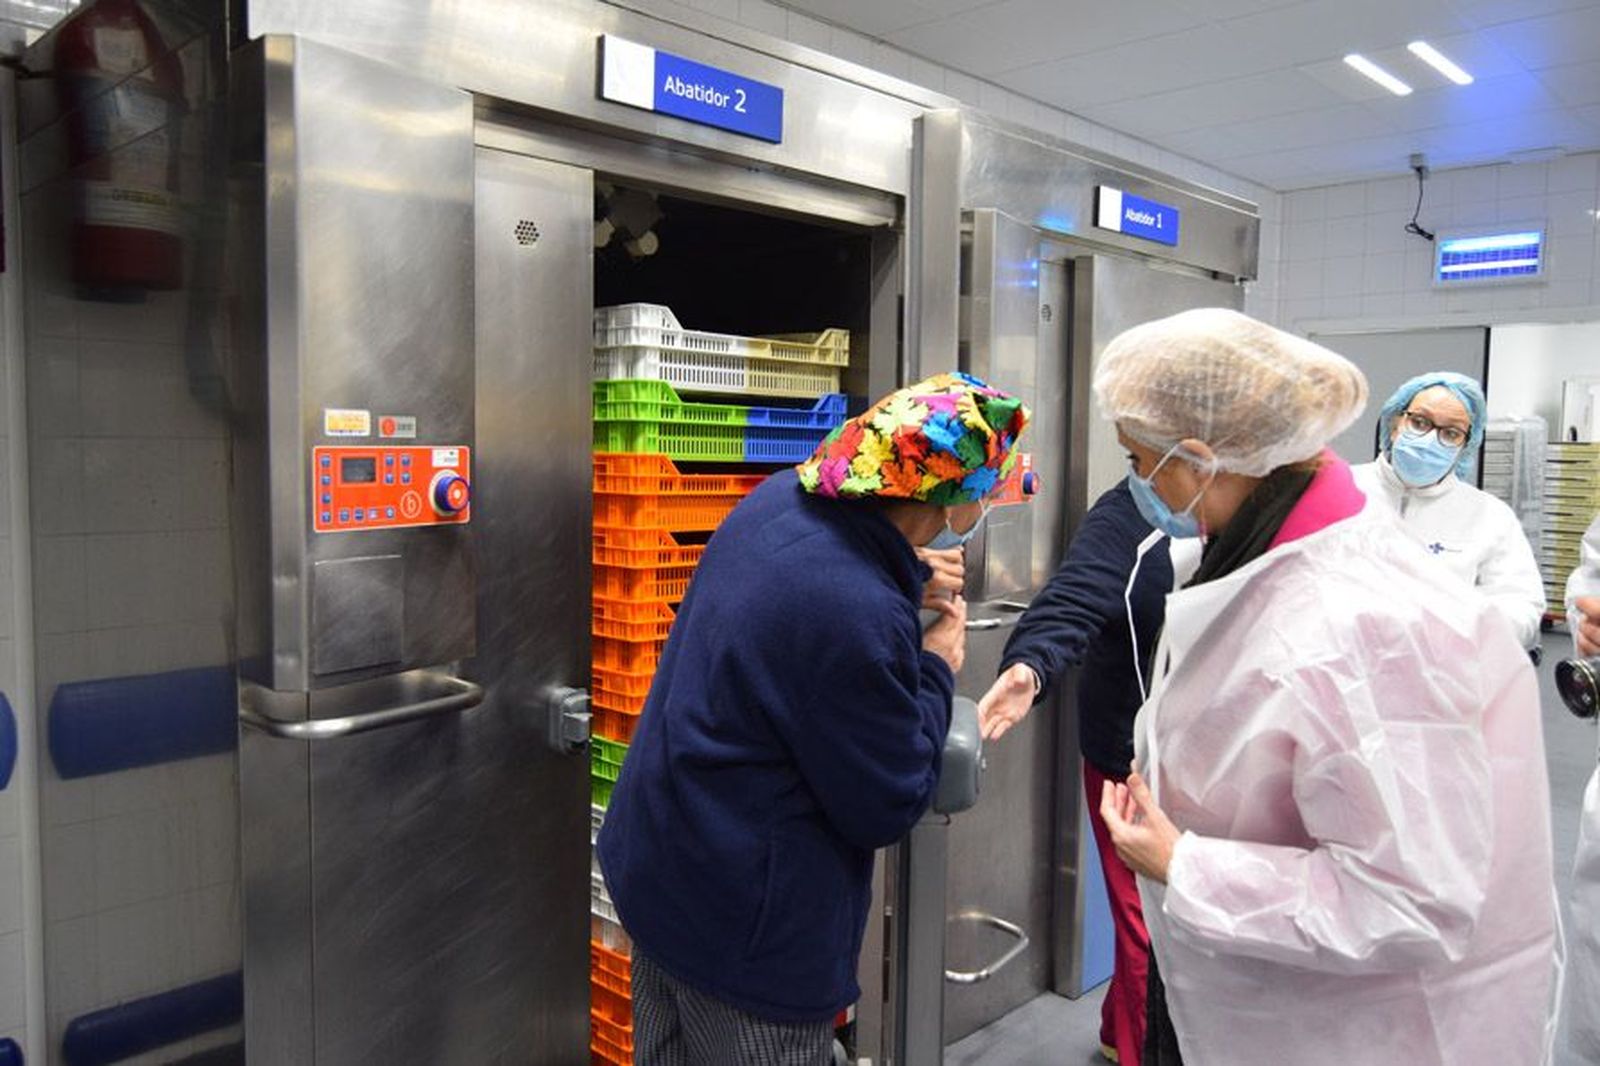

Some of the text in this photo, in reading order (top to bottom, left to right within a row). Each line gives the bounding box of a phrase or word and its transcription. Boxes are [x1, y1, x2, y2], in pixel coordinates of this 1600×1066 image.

[664, 75, 747, 113] Abatidor 2
[1157, 212, 1163, 229] 1
